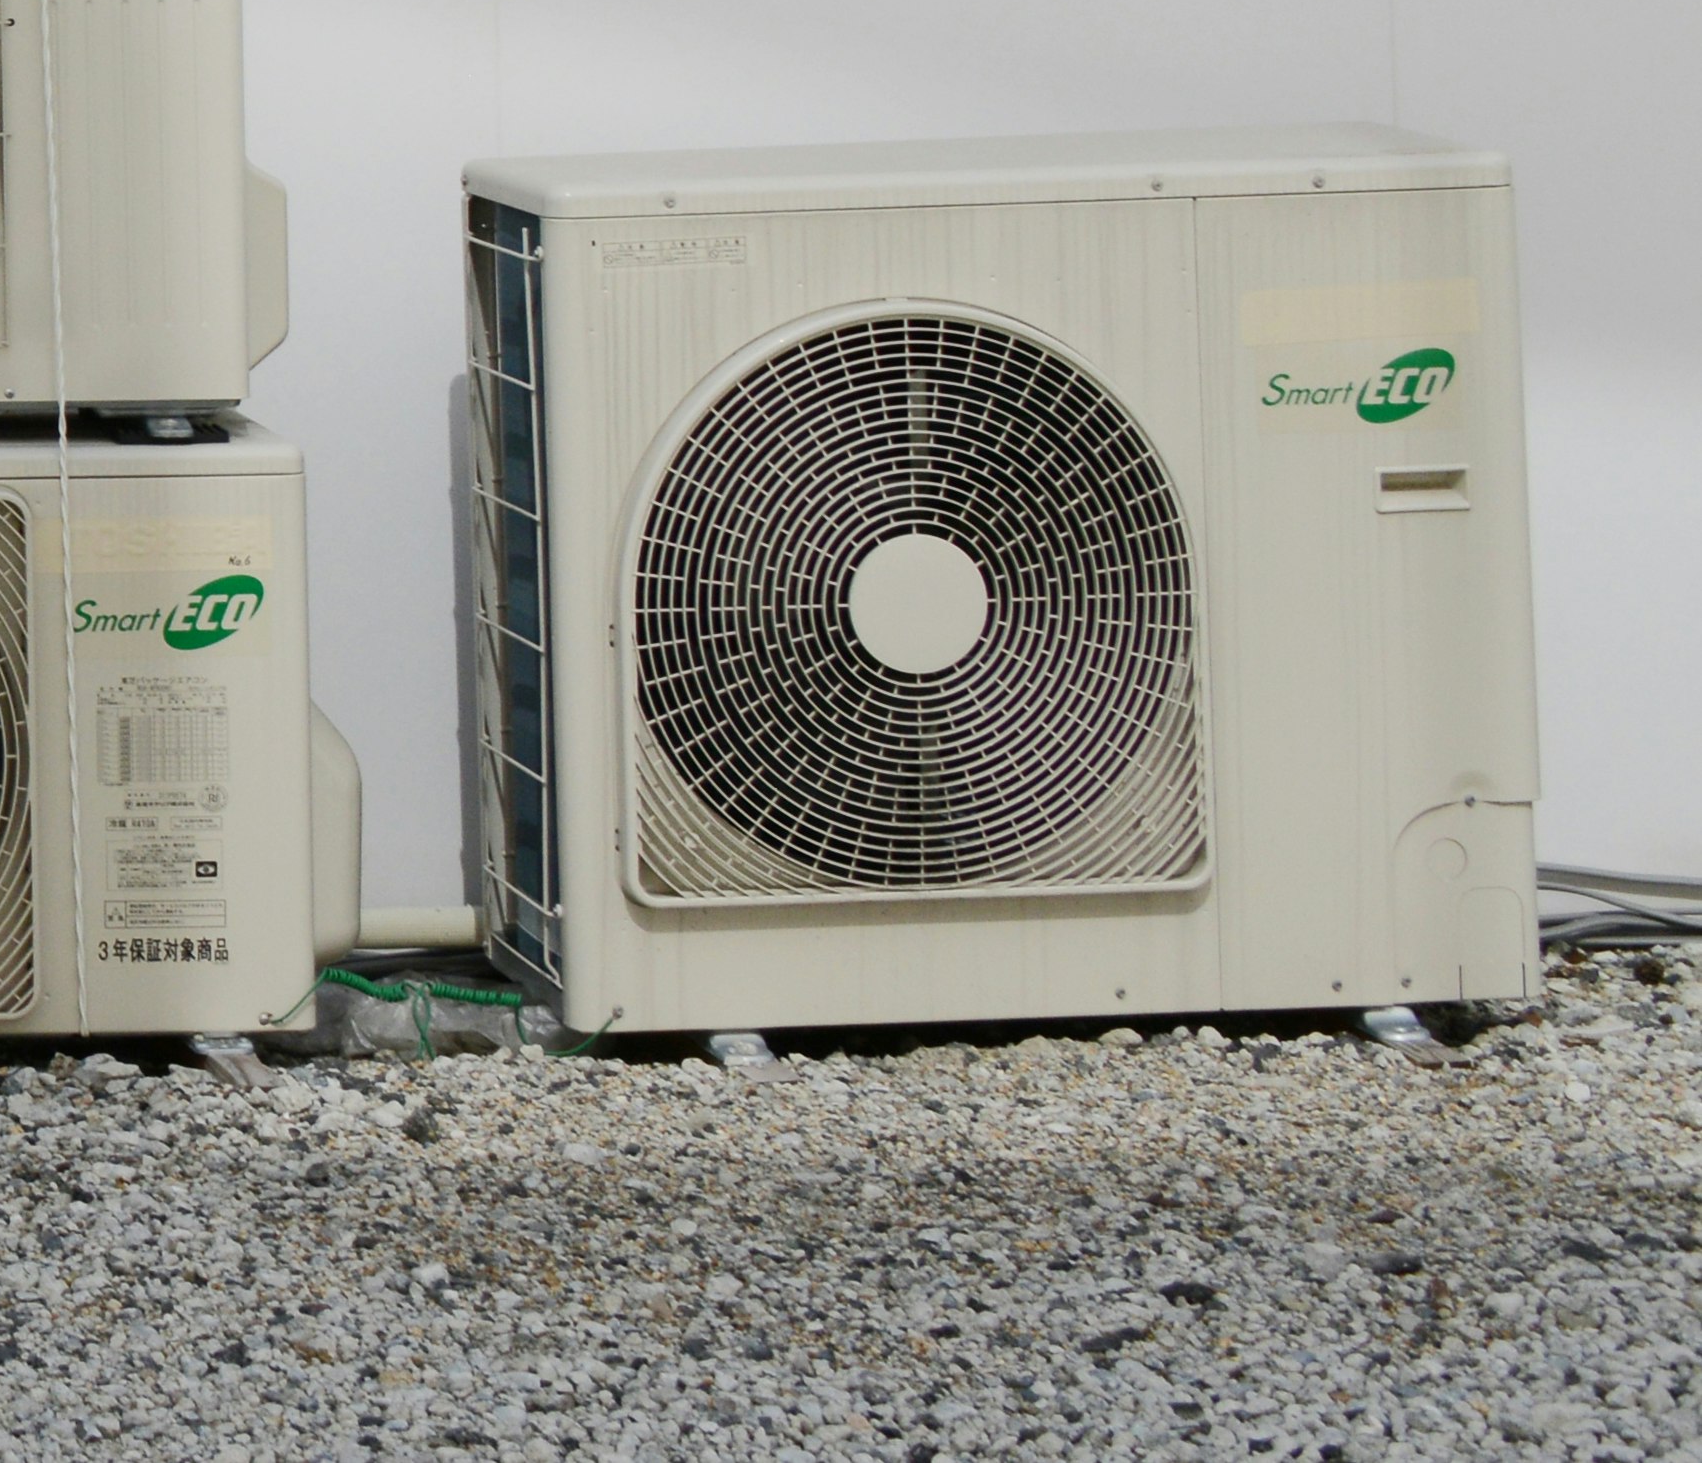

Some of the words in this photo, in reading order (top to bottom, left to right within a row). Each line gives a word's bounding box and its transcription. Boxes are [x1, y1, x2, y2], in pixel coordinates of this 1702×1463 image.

[1260, 371, 1355, 407] Smart
[1359, 365, 1451, 406] ECO
[72, 598, 162, 634] Smart
[166, 592, 260, 632] ECO
[97, 936, 230, 965] 3年保証対象商品
